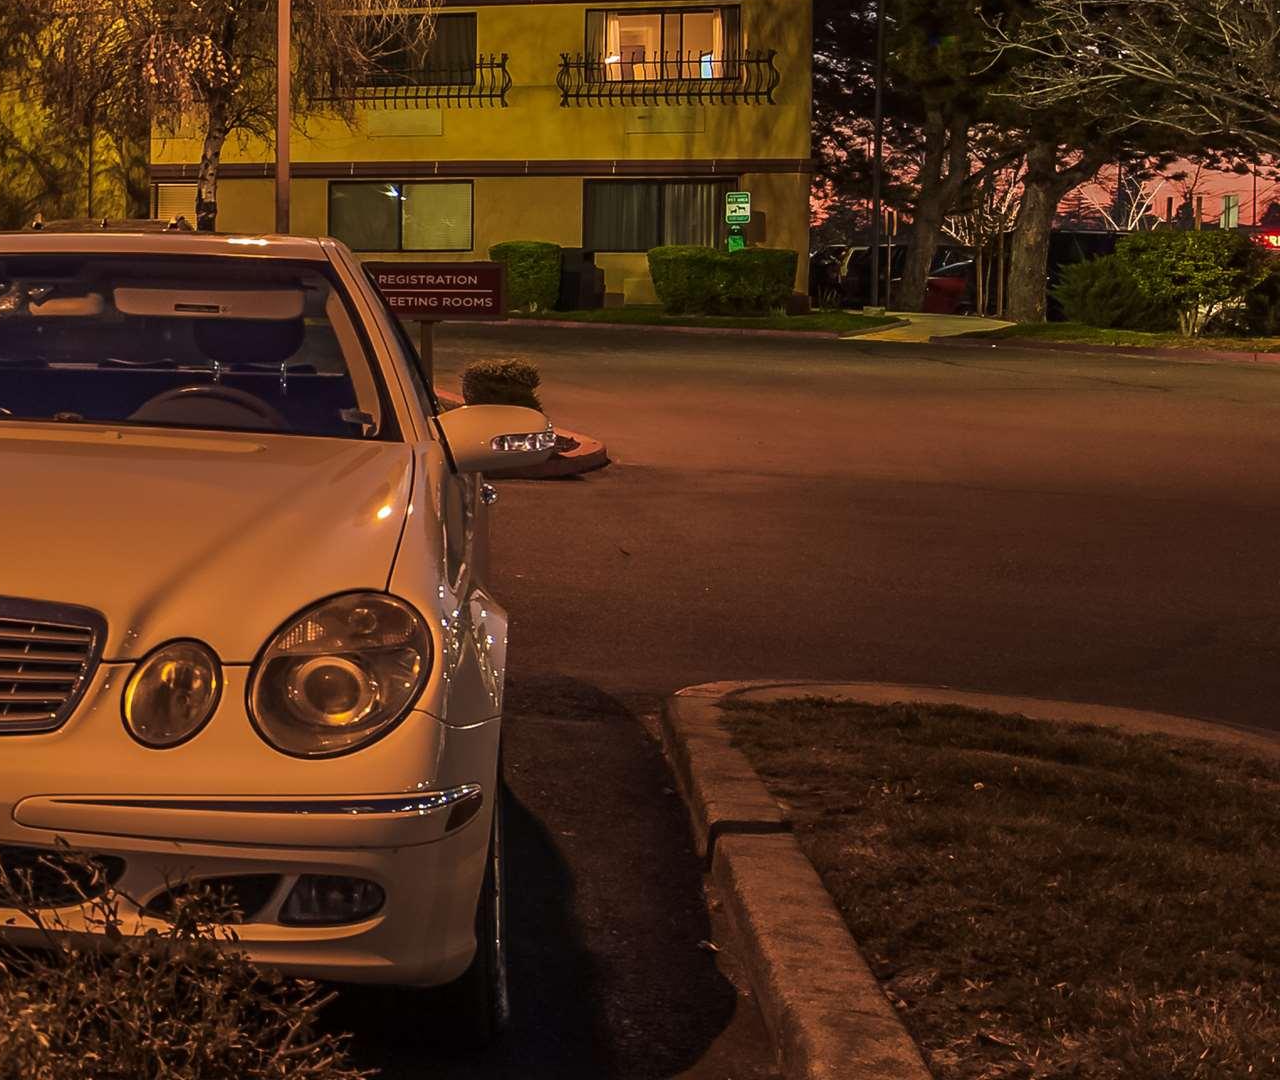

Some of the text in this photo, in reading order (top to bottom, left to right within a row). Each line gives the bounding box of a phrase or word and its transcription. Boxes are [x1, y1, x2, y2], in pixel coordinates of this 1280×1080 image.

[378, 274, 478, 286] REGISTRATION
[385, 296, 493, 308] EETING ROOMS
